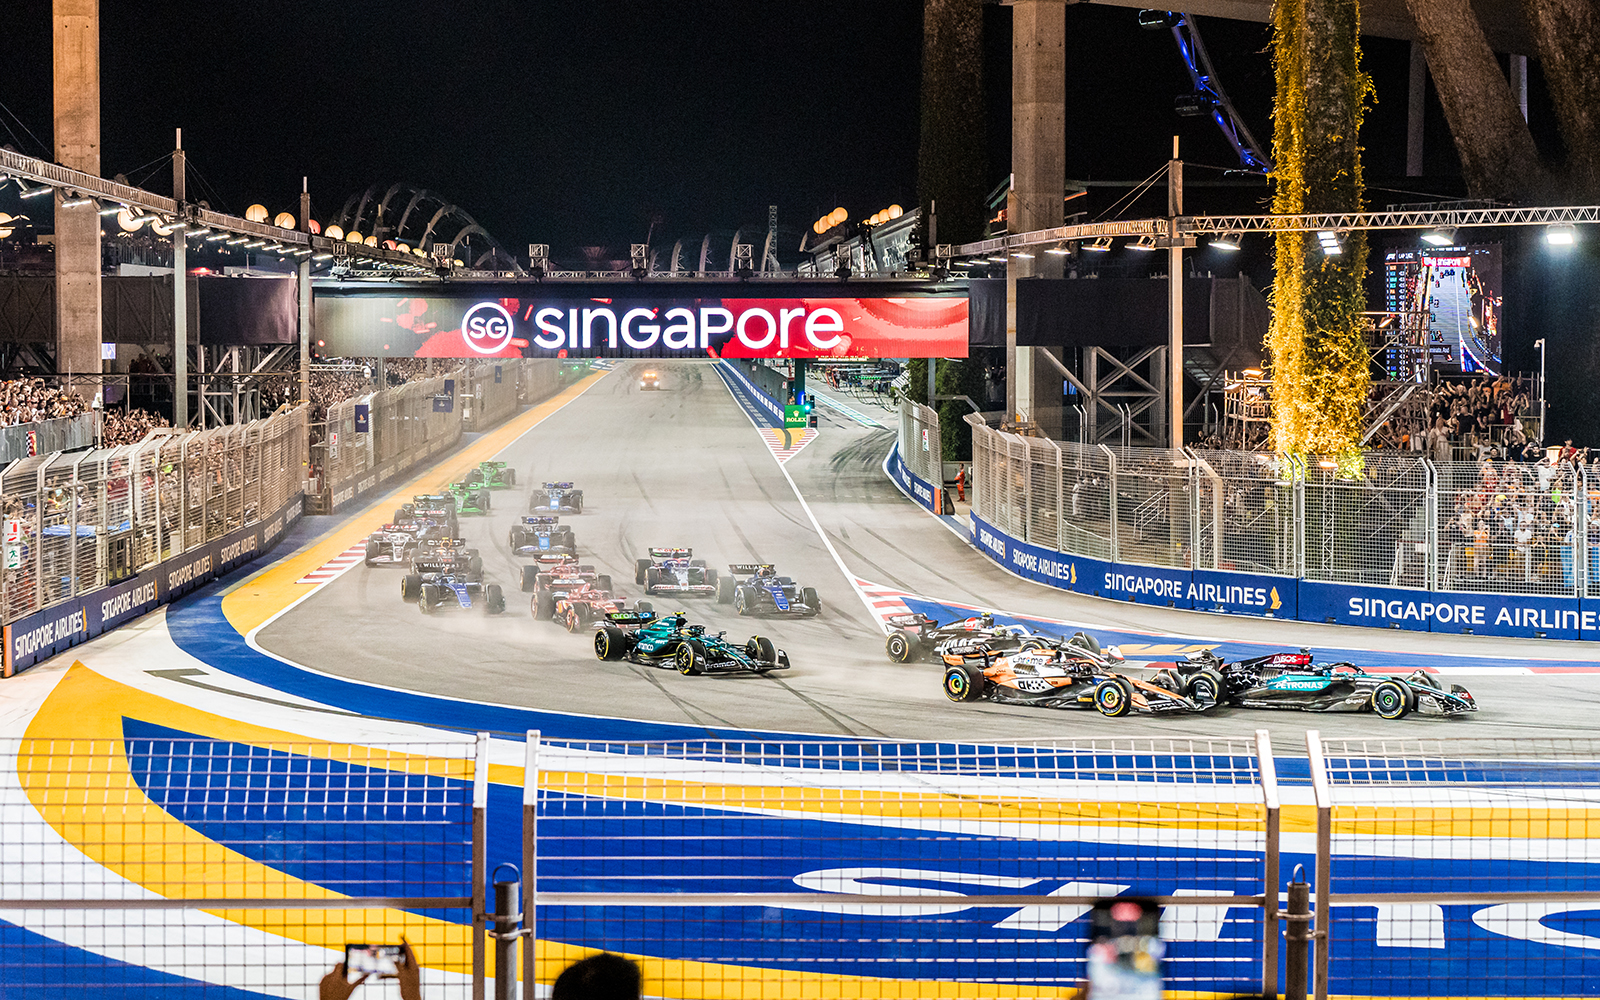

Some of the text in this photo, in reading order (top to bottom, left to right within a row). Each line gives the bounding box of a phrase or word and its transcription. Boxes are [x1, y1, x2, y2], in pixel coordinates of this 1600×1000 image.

[469, 316, 507, 339] SG
[1012, 548, 1070, 580] SINGAPORE AIRLINES
[101, 581, 154, 622] SINGAPORE AIRLINES
[1104, 572, 1267, 606] SINGAPORE AIRLINES
[1348, 597, 1600, 630] SINGAPORE AIRLINE
[15, 610, 83, 660] SINGAPORE AIRLINES
[1275, 681, 1324, 690] PETRONAS
